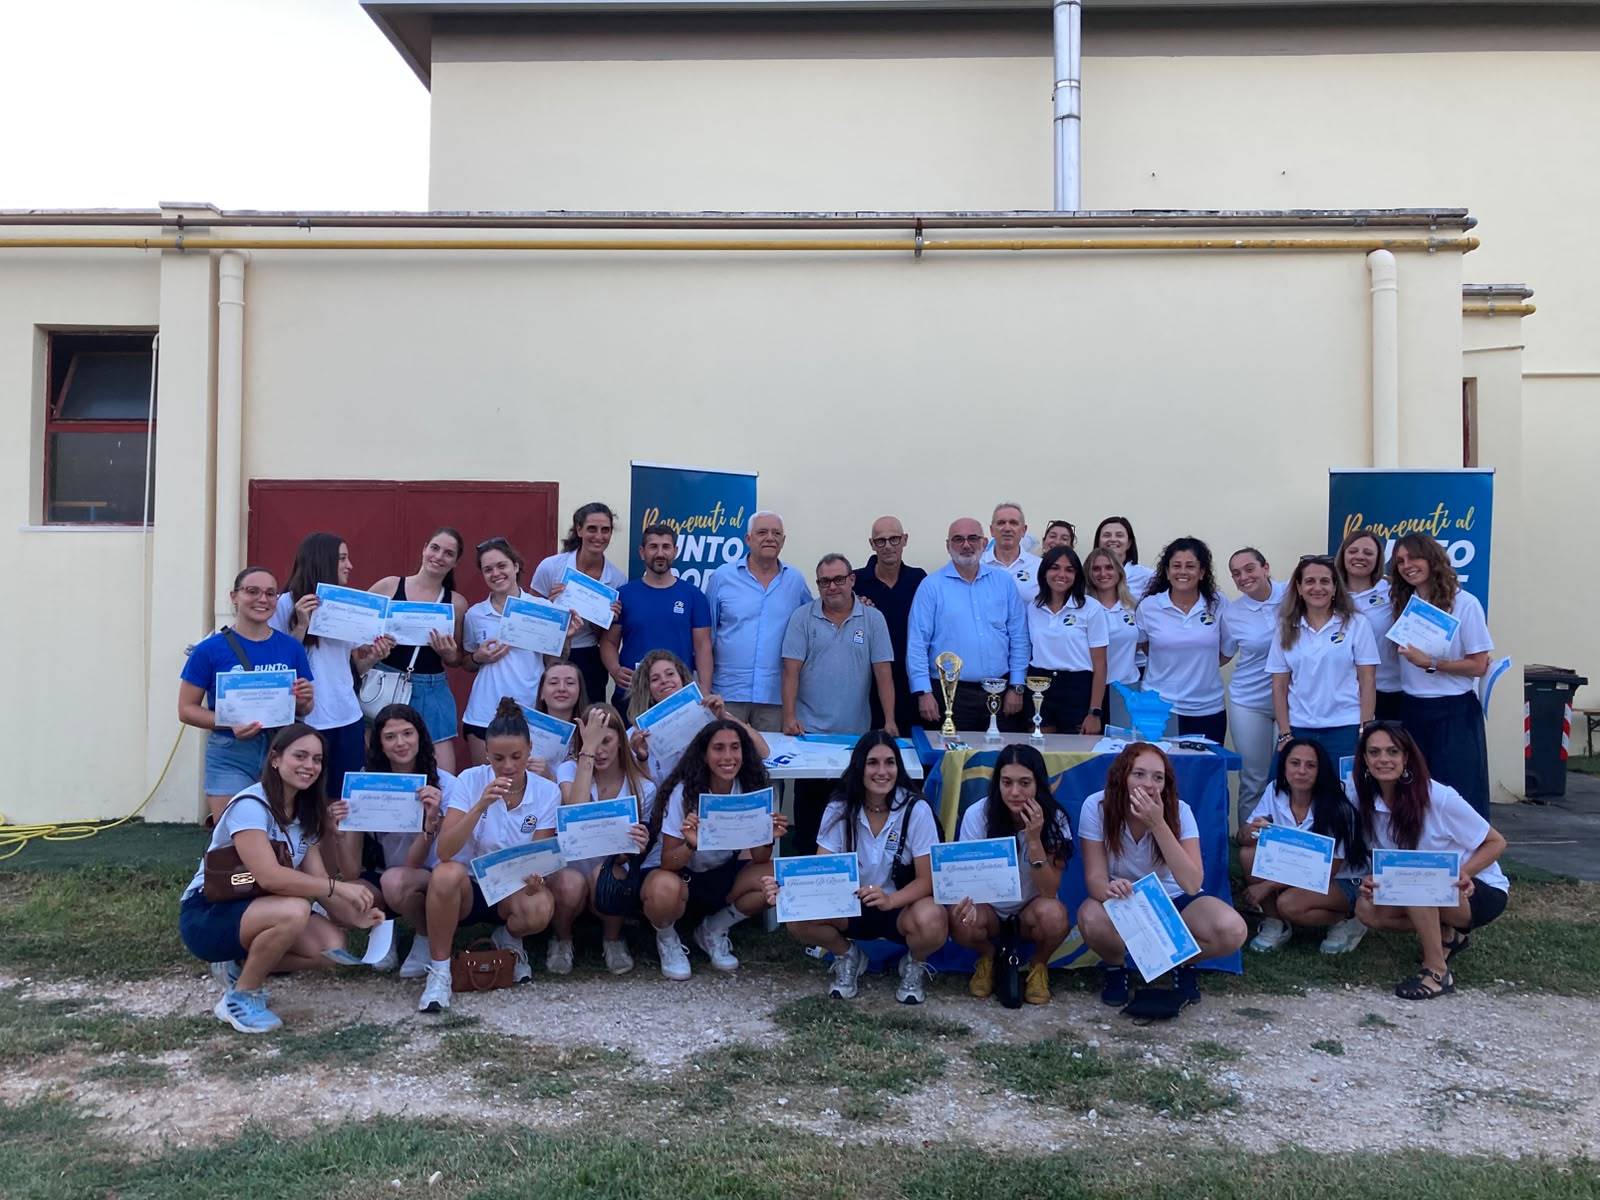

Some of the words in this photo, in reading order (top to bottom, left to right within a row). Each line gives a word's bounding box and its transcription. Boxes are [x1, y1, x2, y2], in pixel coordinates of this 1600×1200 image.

[729, 506, 744, 528] al
[1455, 506, 1475, 531] al
[674, 534, 744, 563] NTO
